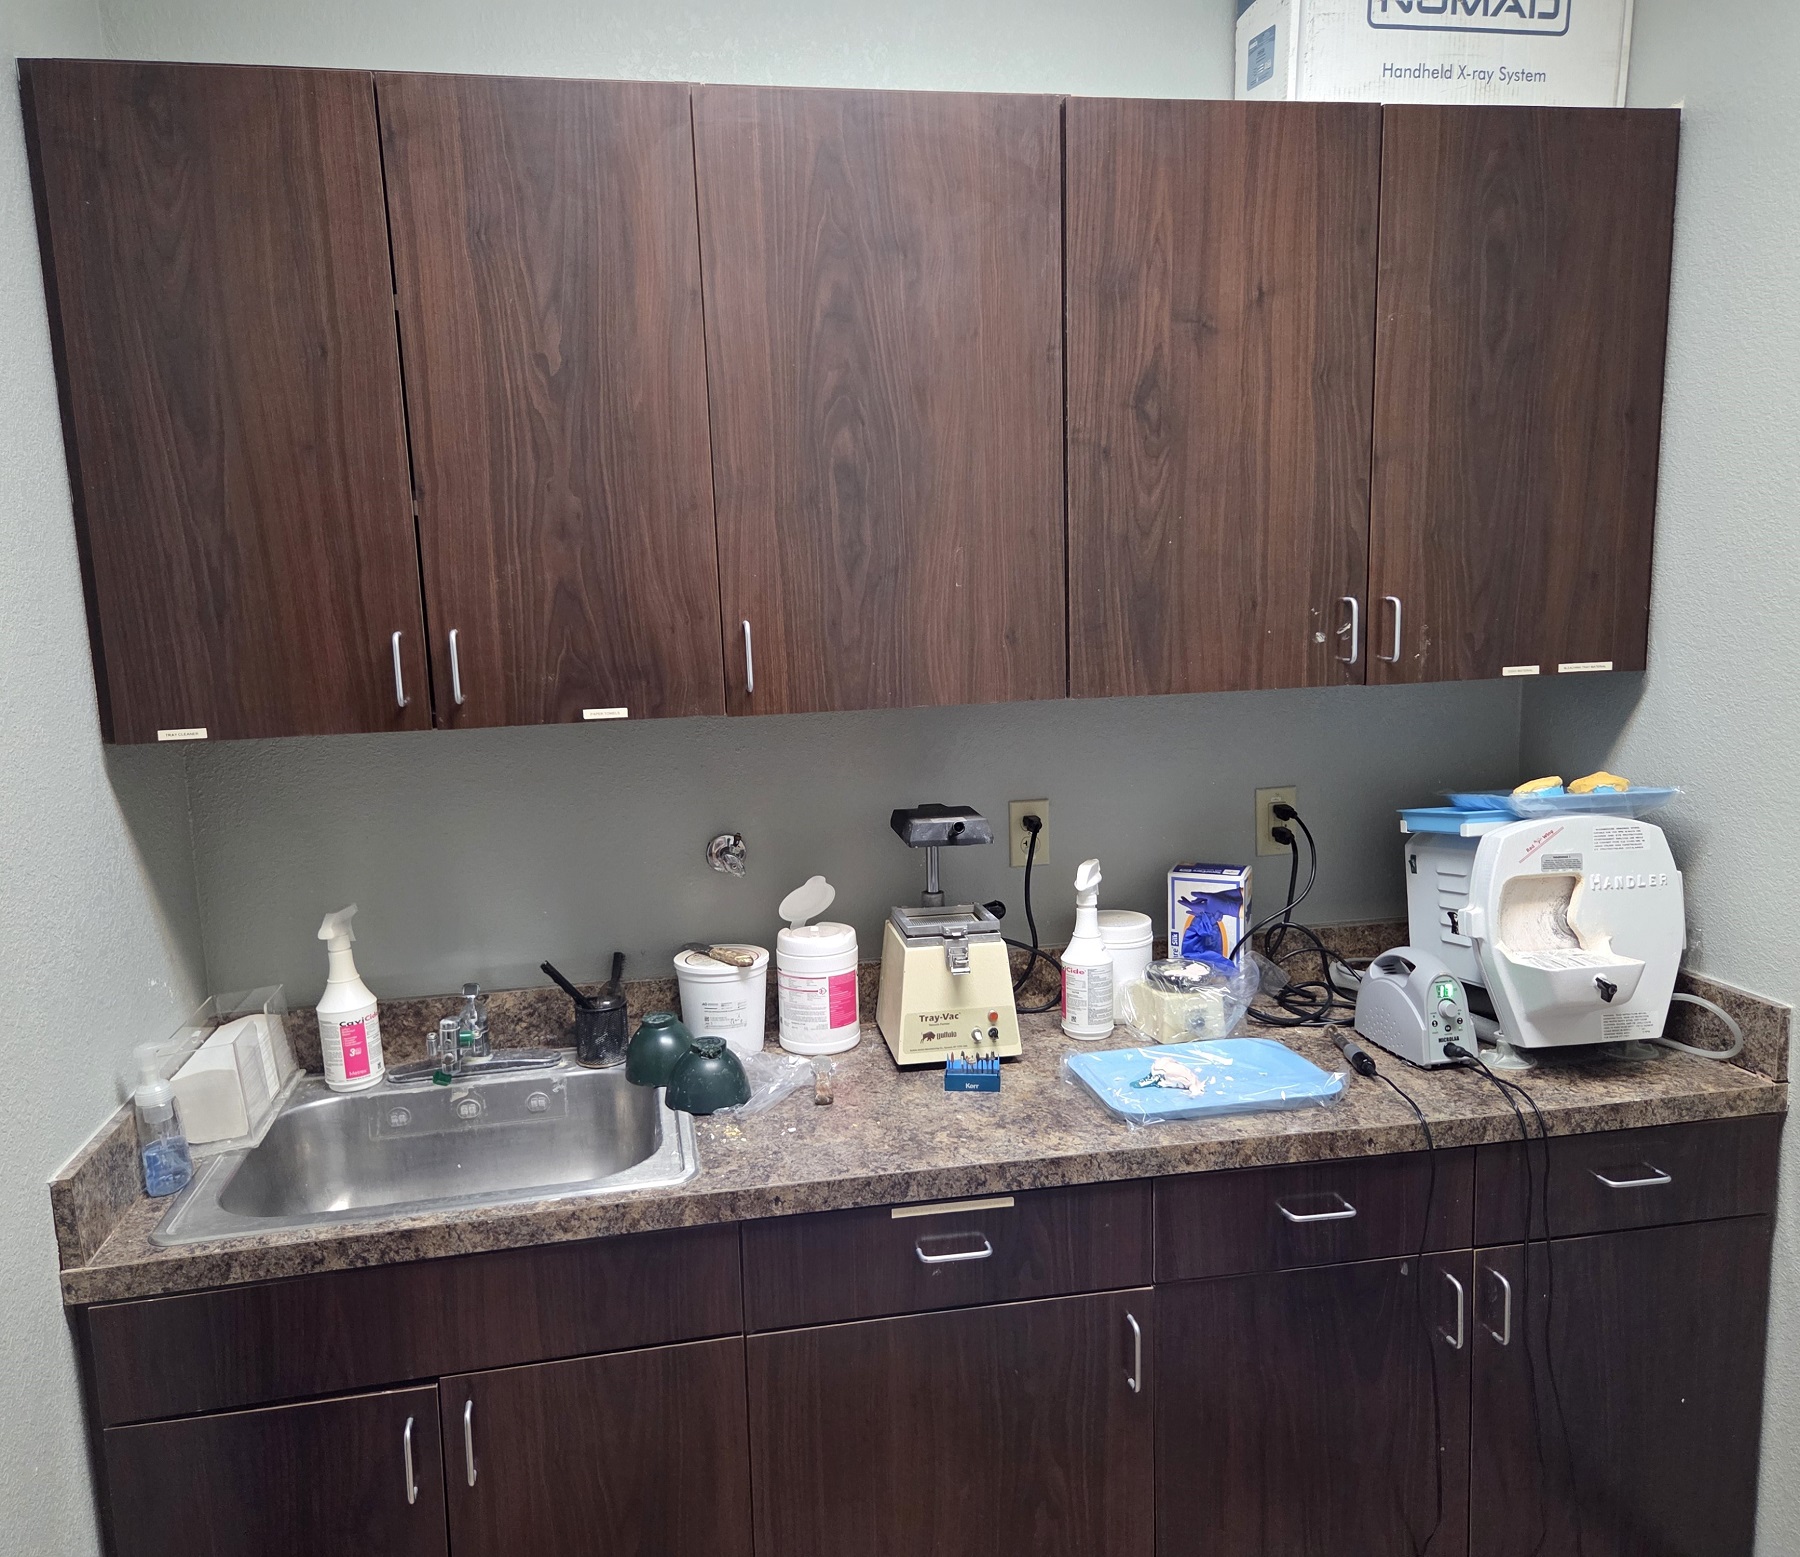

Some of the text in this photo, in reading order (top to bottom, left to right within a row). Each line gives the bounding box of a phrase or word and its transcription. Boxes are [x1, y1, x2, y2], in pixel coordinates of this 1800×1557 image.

[1382, 63, 1547, 85] Handheld X-ray System
[1590, 873, 1668, 892] HANDLER
[919, 1012, 960, 1024] Tray-Vac
[965, 1082, 980, 1090] Kerr
